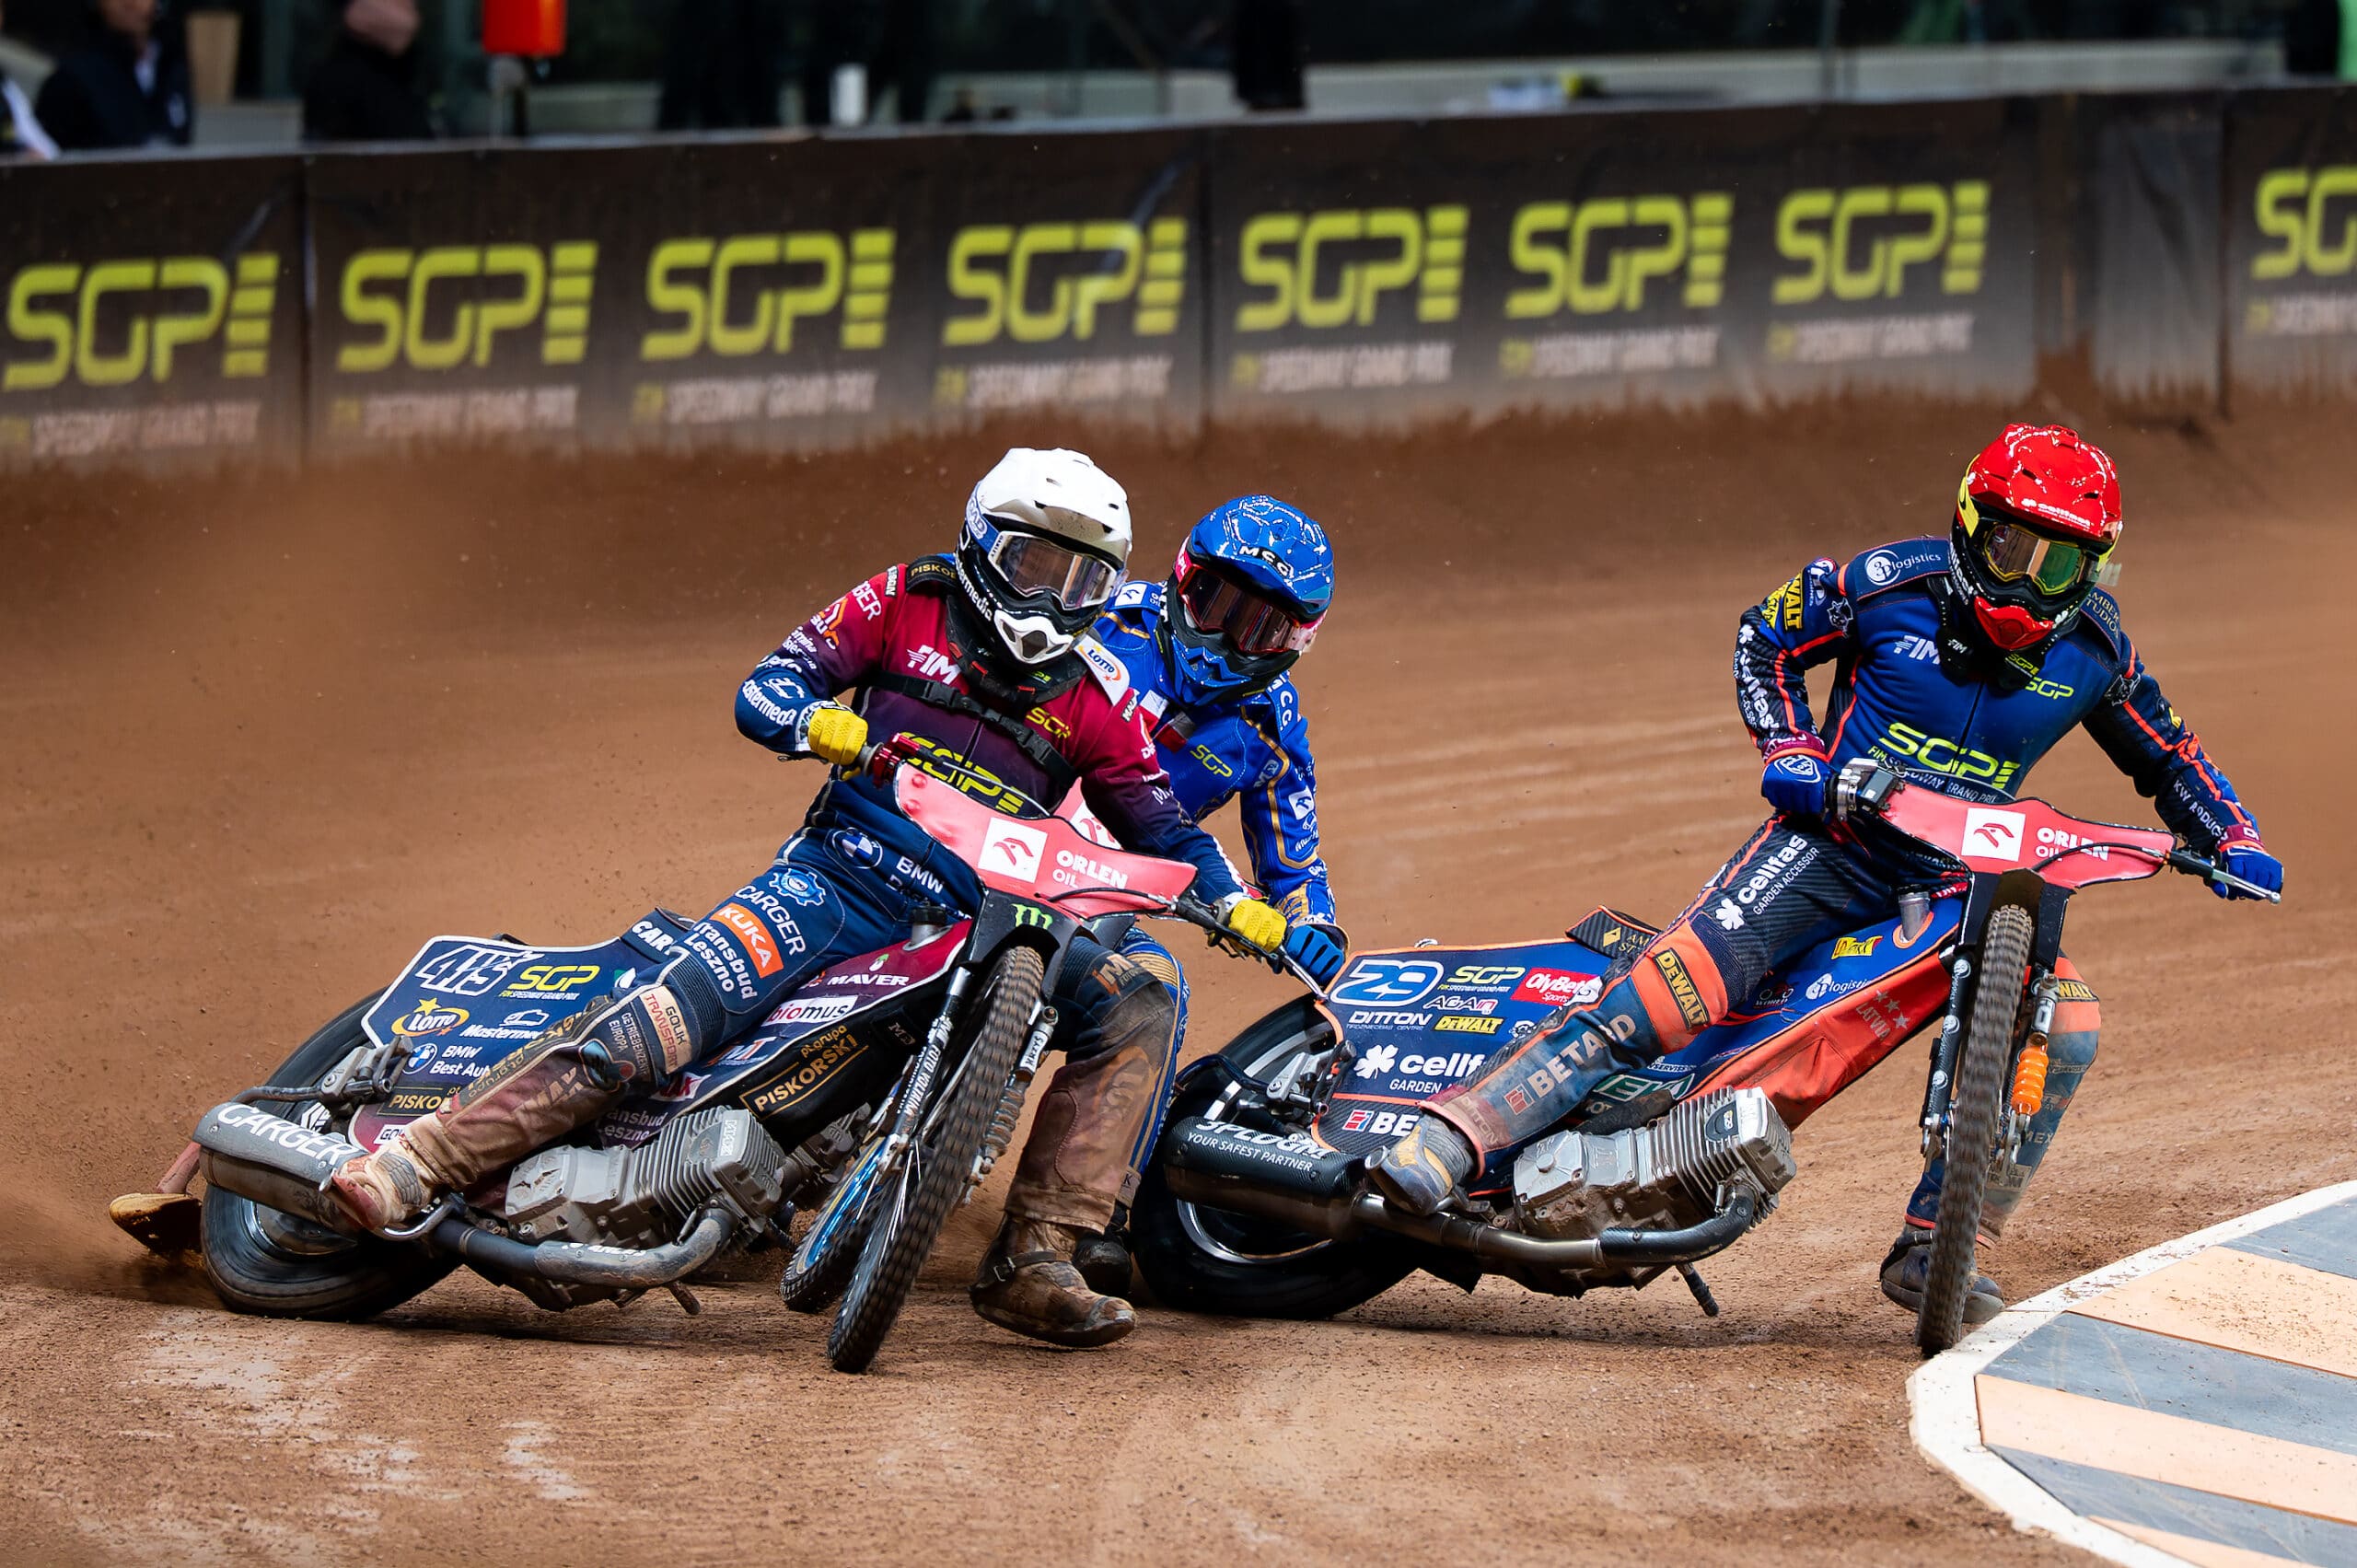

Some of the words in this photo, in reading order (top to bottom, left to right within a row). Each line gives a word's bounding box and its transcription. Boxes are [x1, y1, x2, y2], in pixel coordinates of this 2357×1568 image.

[2251, 167, 2357, 279] SG
[906, 645, 962, 685] FIM
[1087, 649, 1116, 675] LOTTO
[1190, 744, 1234, 777] SGP
[1878, 722, 2000, 778] SGP
[896, 856, 944, 894] BMW
[1052, 869, 1079, 889] OIL
[1056, 850, 1129, 889] ORLEN
[1738, 834, 1808, 904] cellfas
[1752, 882, 1785, 915] GARDEN
[718, 908, 772, 969] KUKA
[735, 886, 807, 956] CARGER
[507, 965, 601, 991] SGP
[683, 933, 735, 993] Leszno
[827, 974, 910, 986] MAVER
[1446, 966, 1526, 984] SGP
[1330, 959, 1445, 1006] 29
[408, 1013, 457, 1031] LOTTO
[608, 1020, 630, 1053] EUROPA
[644, 994, 679, 1069] TRANSPORT
[666, 1006, 689, 1046] GOLIK
[1348, 1011, 1434, 1026] DITTON
[1856, 1003, 1892, 1041] LATVIA
[430, 1061, 464, 1076] Best
[442, 1045, 483, 1058] BMW
[1399, 1052, 1486, 1078] cellf
[1527, 1015, 1636, 1098] BETAD
[754, 1034, 857, 1112] PISKORSKI
[1388, 1079, 1441, 1094] GARDEN
[217, 1102, 357, 1166] CARGER
[1188, 1132, 1219, 1149] YOUR
[1218, 1141, 1261, 1159] SAFEST
[1260, 1152, 1313, 1171] PARTNER
